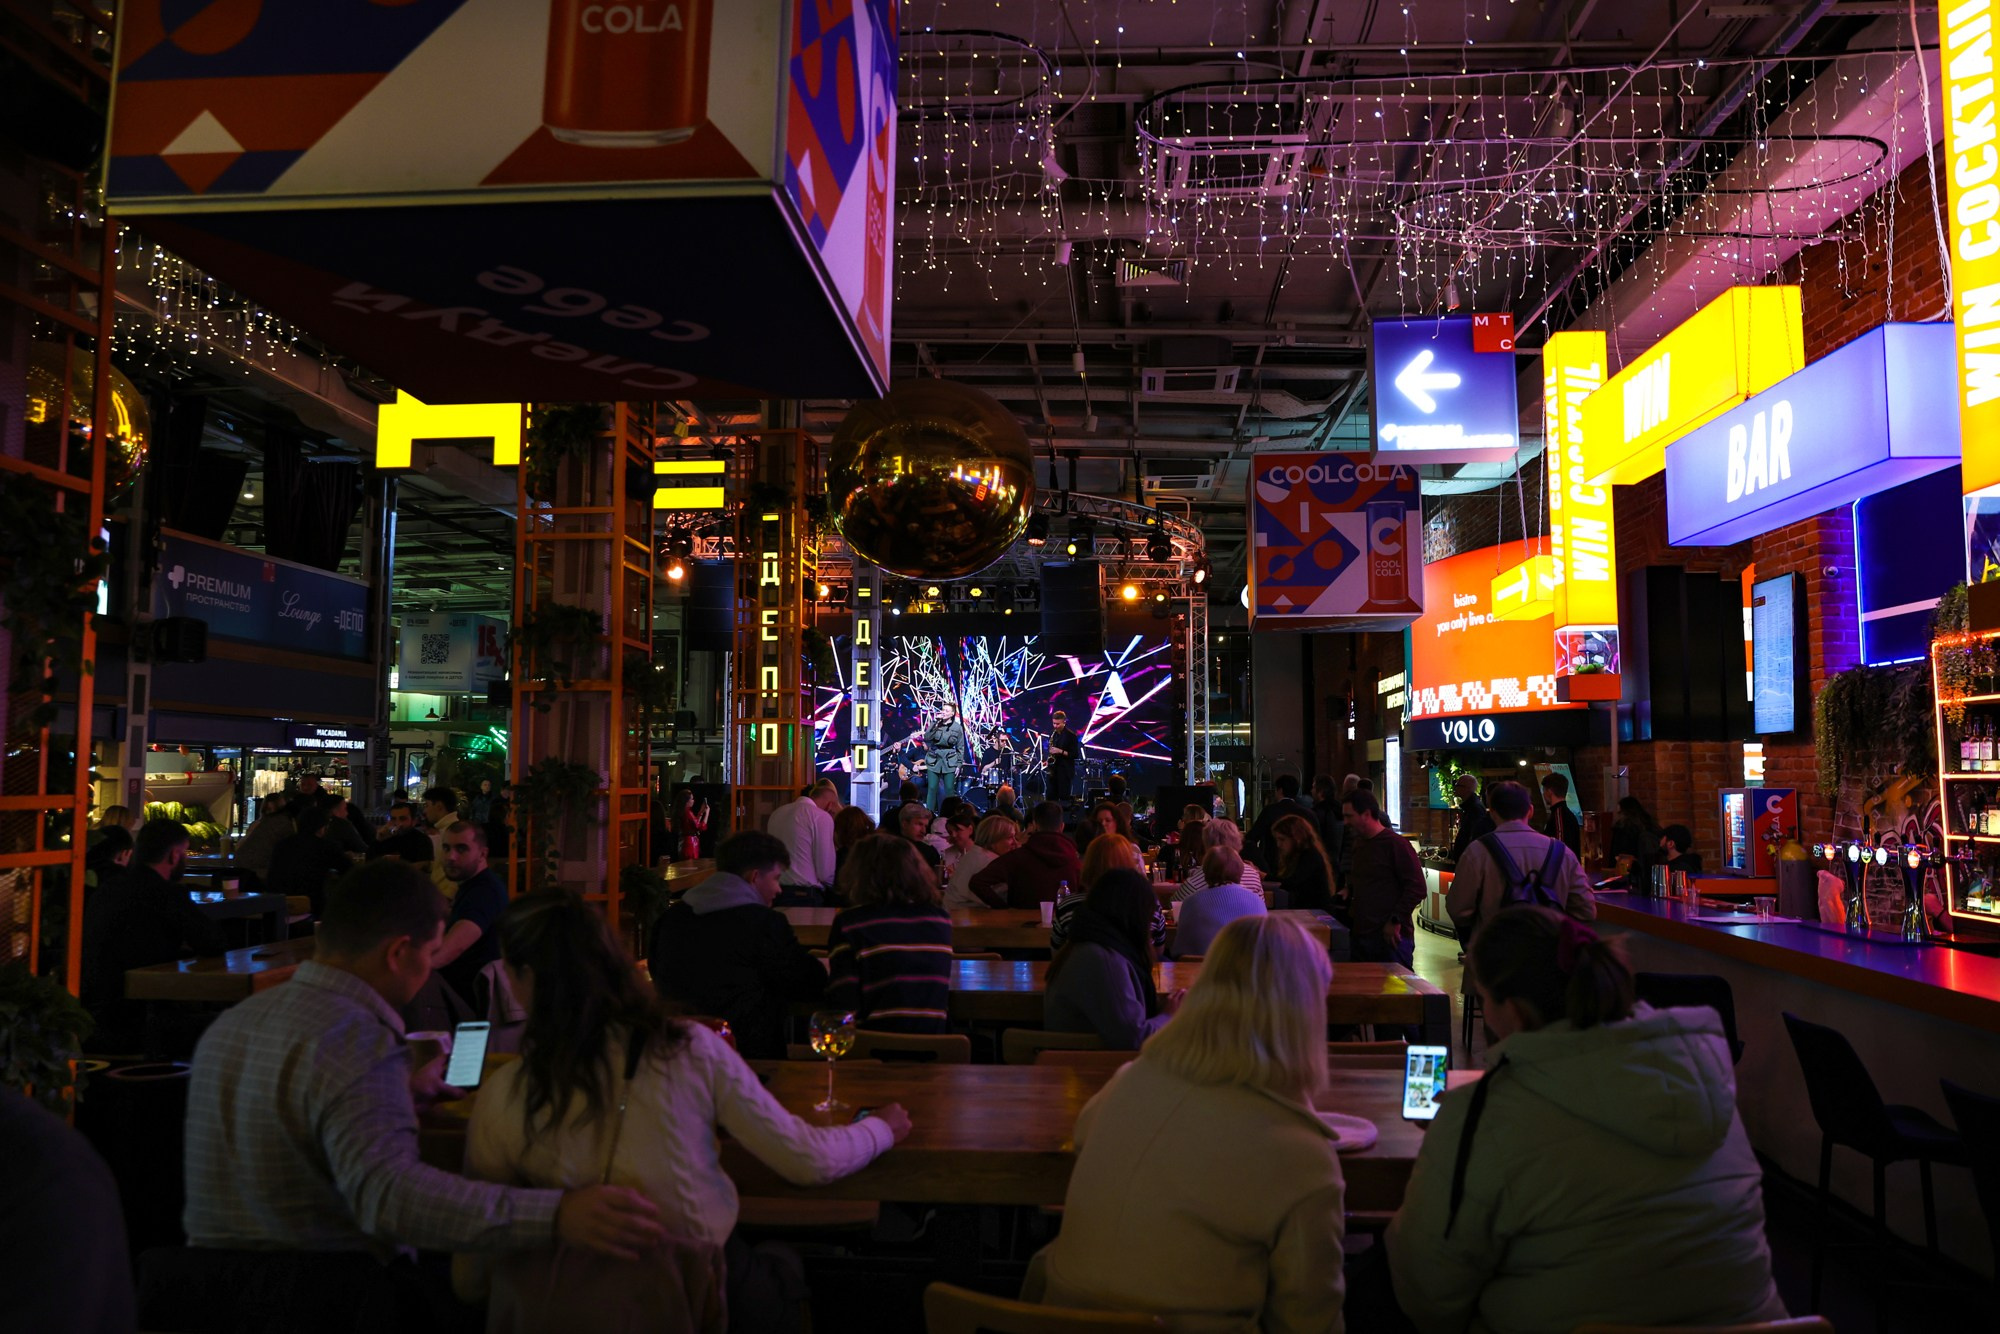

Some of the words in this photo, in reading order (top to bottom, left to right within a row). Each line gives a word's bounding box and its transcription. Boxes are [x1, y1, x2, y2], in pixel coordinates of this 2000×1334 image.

[580, 3, 683, 34] COLA
[475, 265, 711, 343] себе
[1623, 353, 1670, 443] WIN
[1545, 367, 1561, 510] COCKTAIL
[1726, 399, 1793, 503] BAR
[1268, 463, 1408, 485] COOLCOLA
[1571, 517, 1610, 581] WIN
[1375, 560, 1401, 568] COOL
[1375, 568, 1401, 577] COLA
[186, 572, 251, 601] PREMIUM
[186, 592, 251, 614] ПРОСТРАНСТВО
[278, 590, 323, 631] Lounge
[1453, 593, 1478, 608] bistro
[1436, 621, 1450, 637] you
[1451, 613, 1468, 632] only
[1469, 611, 1485, 626] live
[295, 737, 321, 748] VITAMIN
[325, 739, 353, 749] SMOOTHIE
[353, 740, 366, 750] BAR
[316, 729, 347, 737] MACADAMIA
[1441, 718, 1495, 744] YOLO
